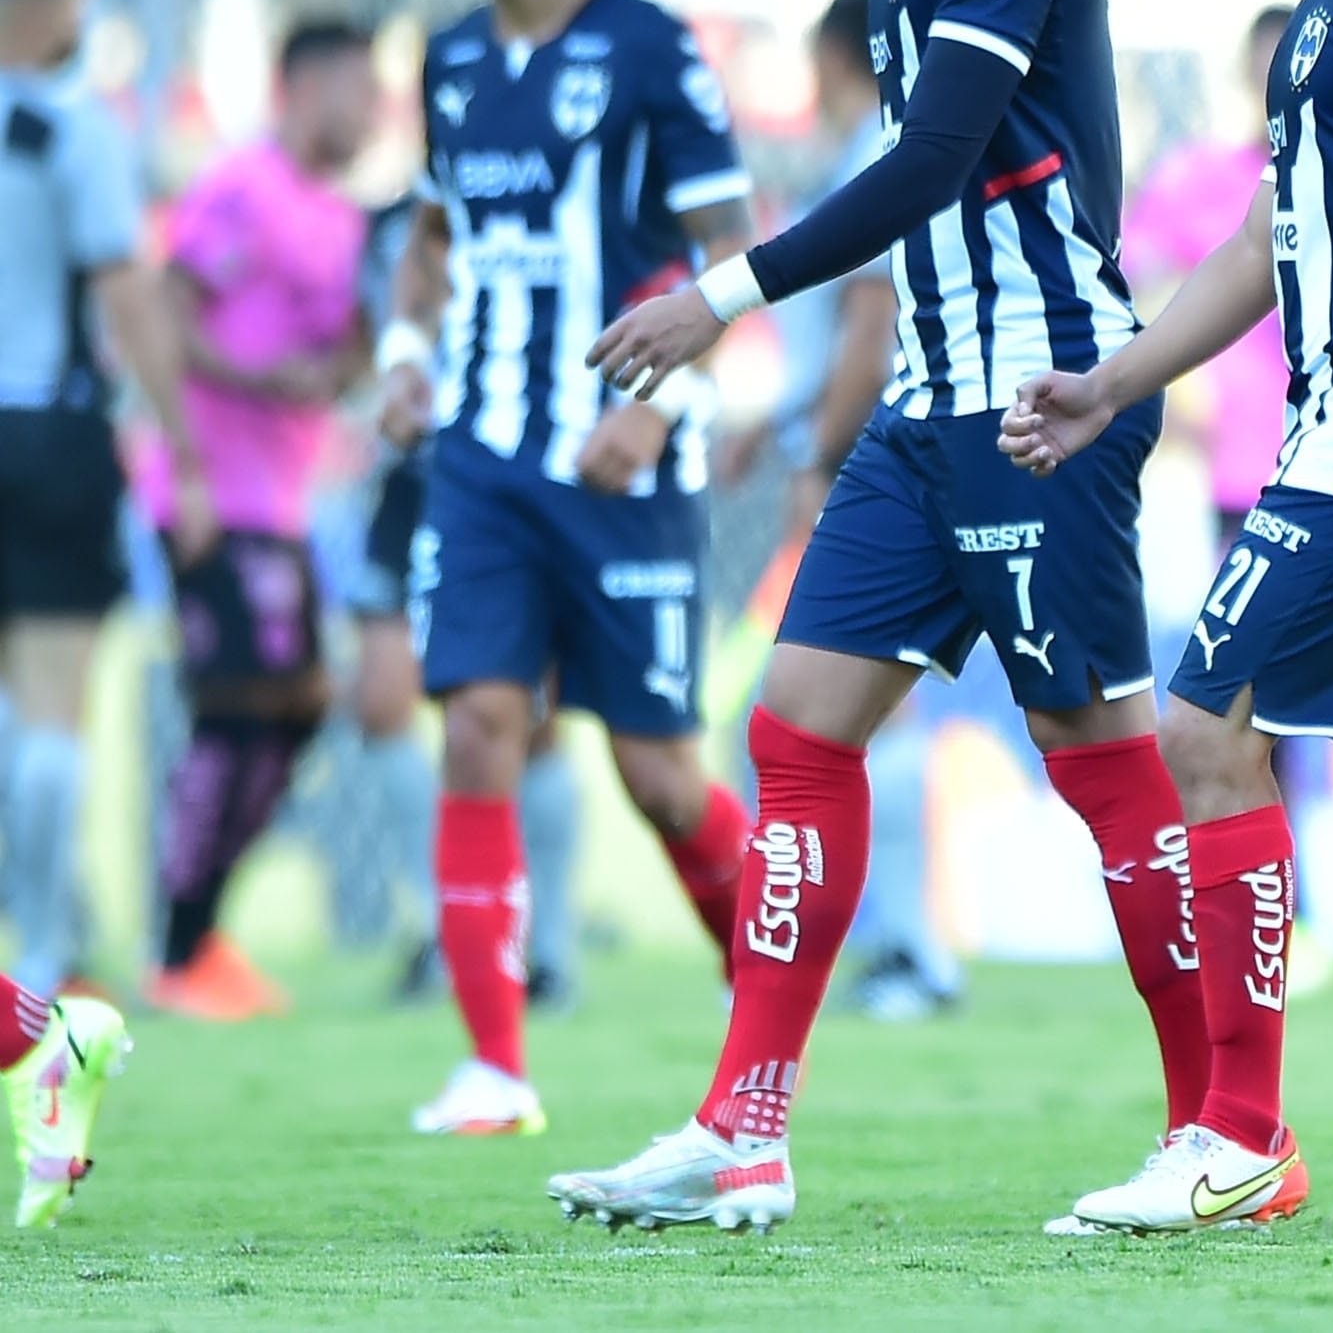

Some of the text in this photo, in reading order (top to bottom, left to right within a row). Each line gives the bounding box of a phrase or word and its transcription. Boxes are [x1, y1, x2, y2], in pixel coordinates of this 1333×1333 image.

[1006, 558, 1035, 632] 7
[1204, 547, 1272, 627] 21
[746, 821, 804, 964] Escudo
